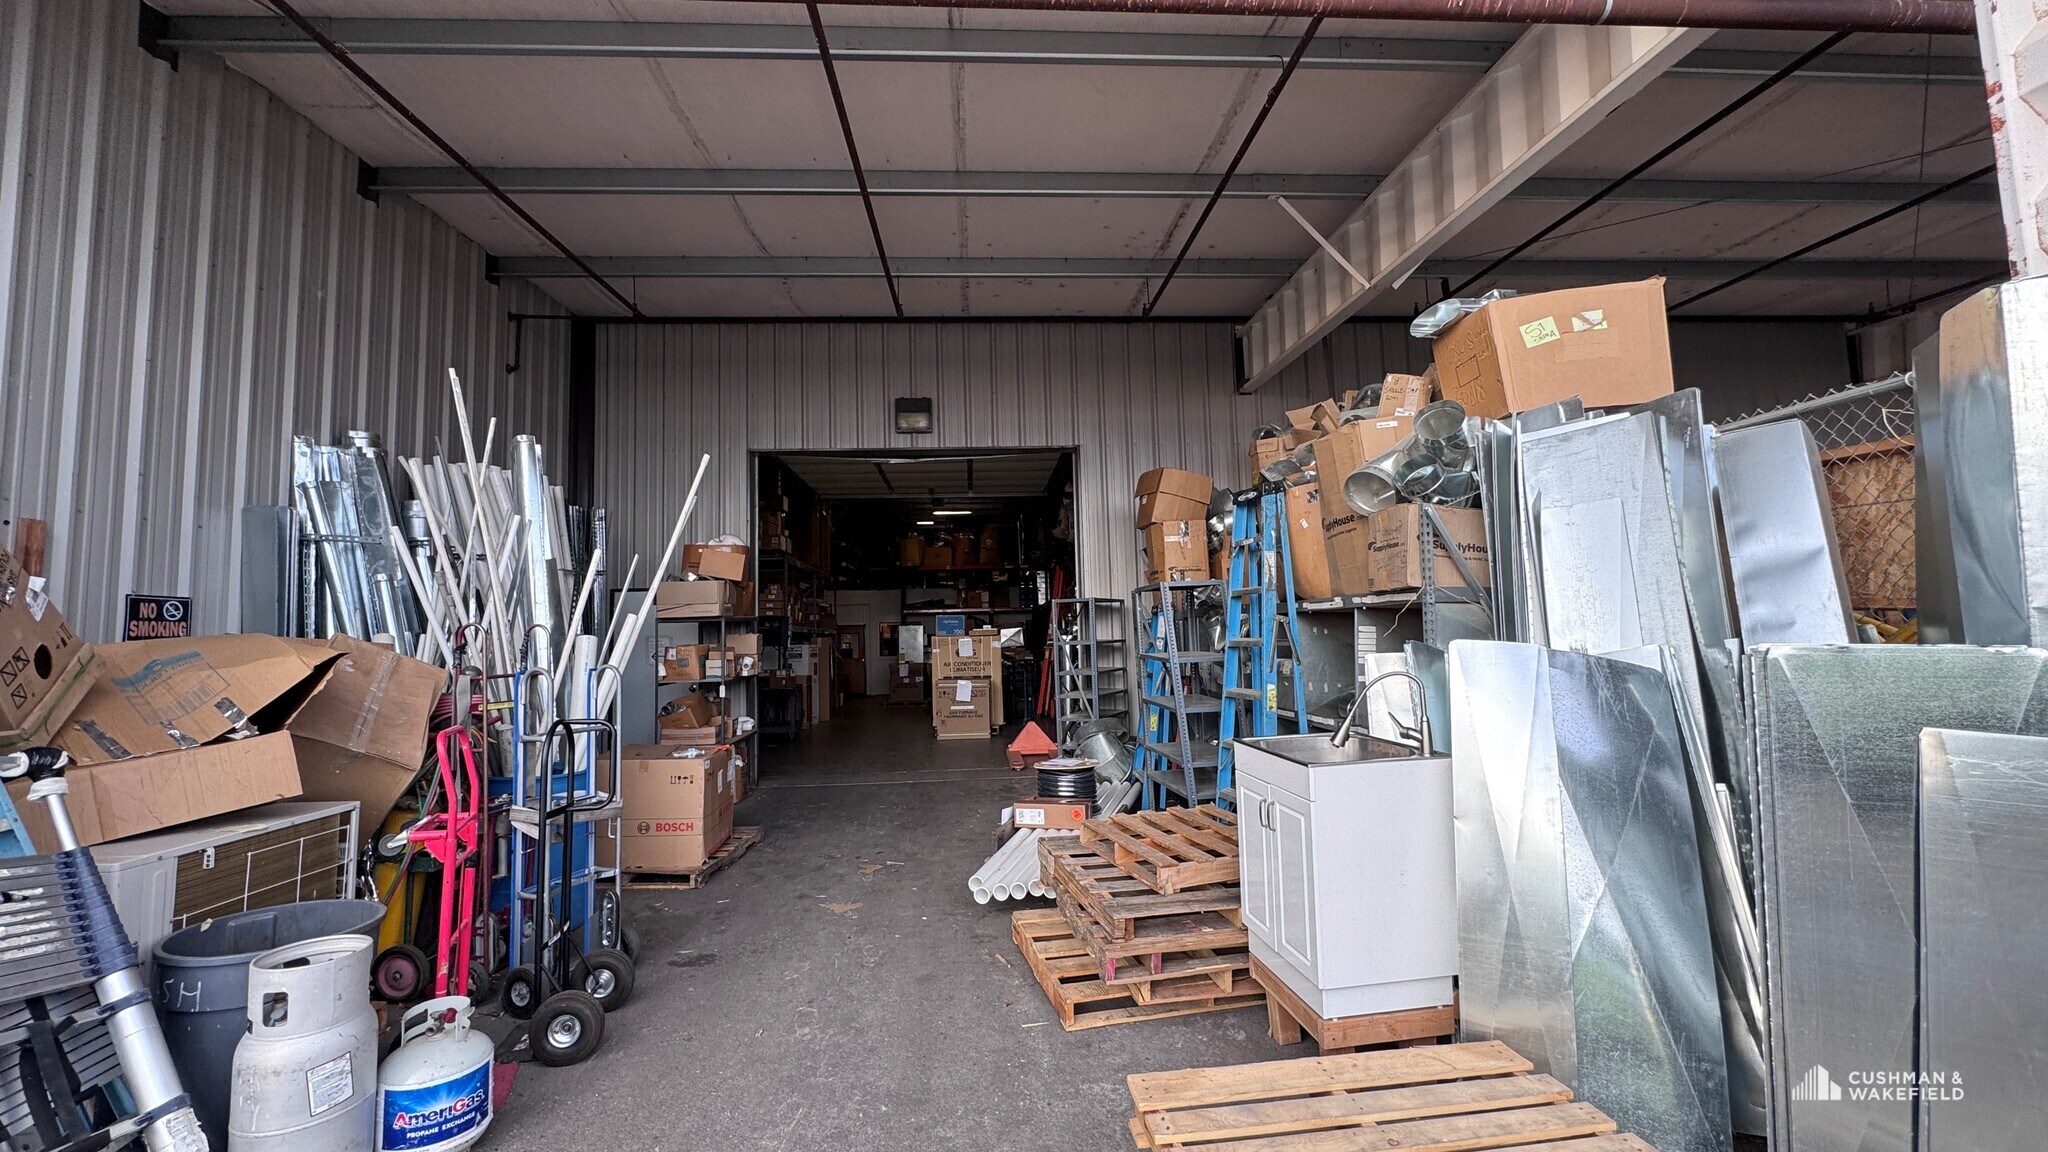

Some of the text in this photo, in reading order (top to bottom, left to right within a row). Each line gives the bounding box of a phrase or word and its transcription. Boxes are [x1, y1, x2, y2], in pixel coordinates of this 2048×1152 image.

[139, 602, 157, 619] NO
[129, 620, 188, 638] SMOKING
[655, 822, 694, 832] BOSCH
[393, 1089, 485, 1130] AmeriGas
[406, 1111, 476, 1139] PROPANE EXCHANGE
